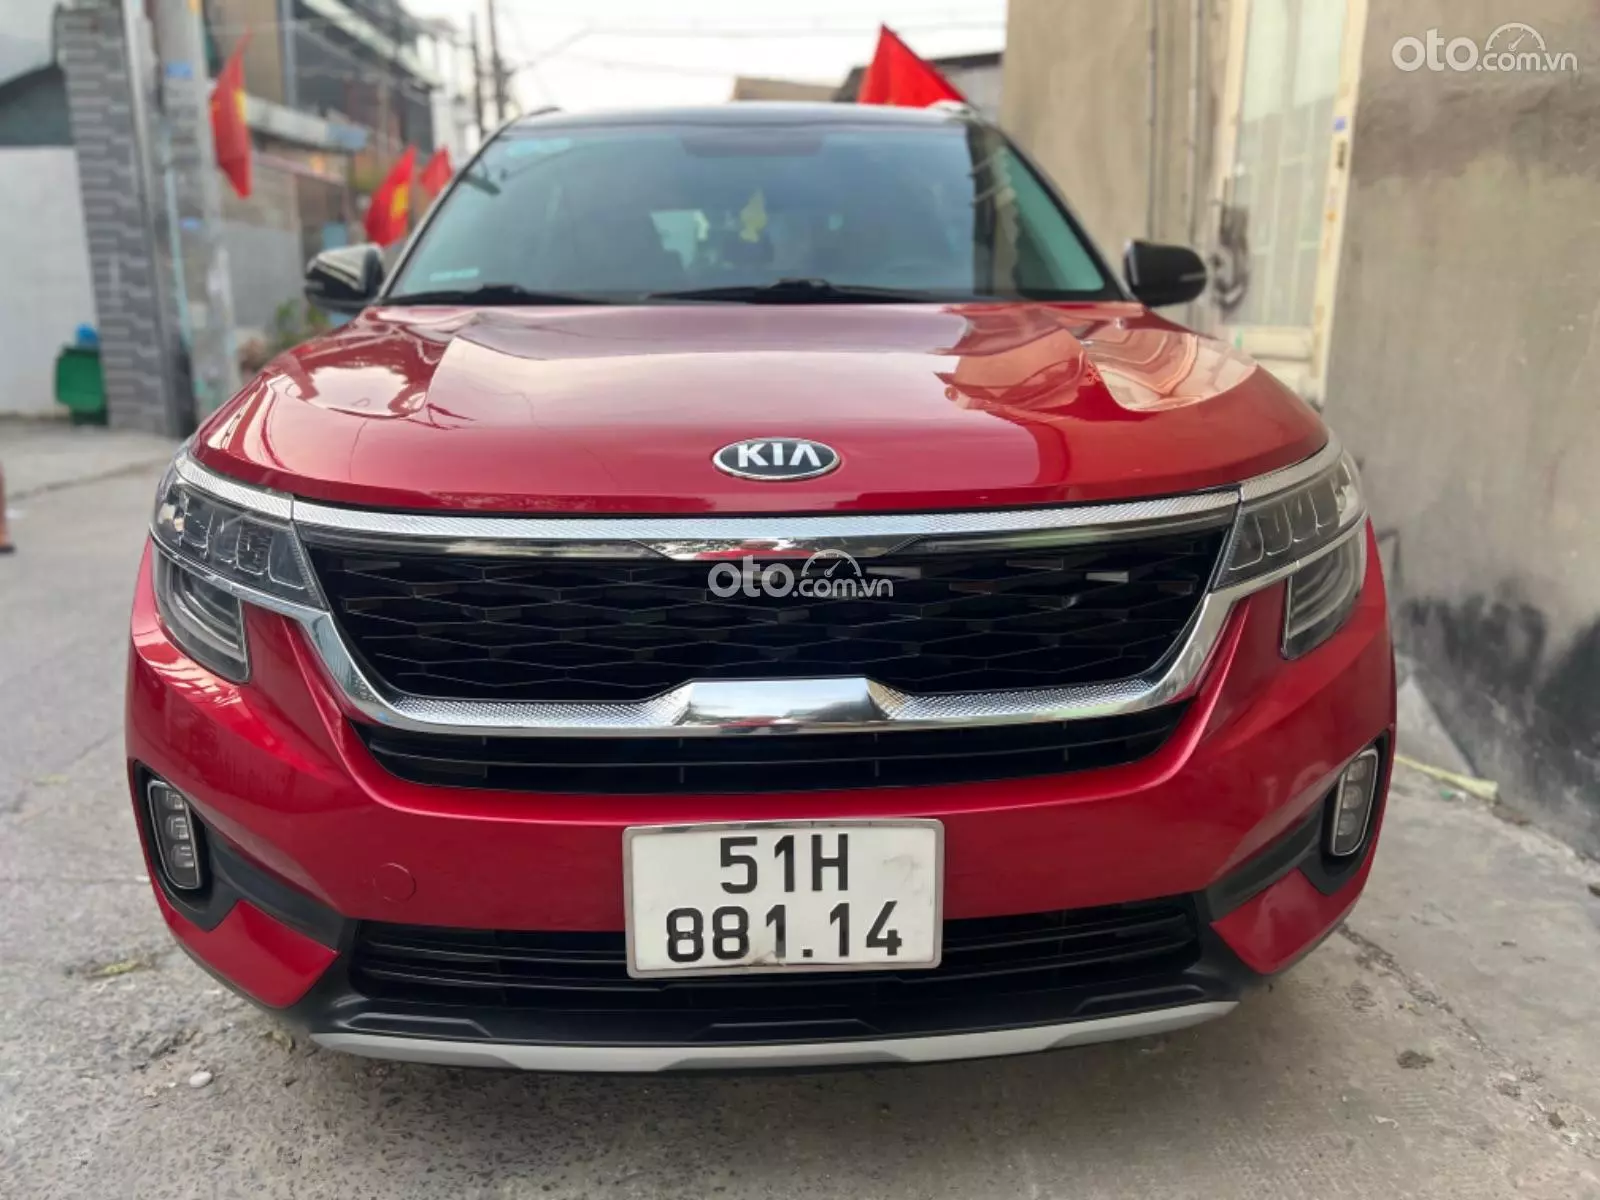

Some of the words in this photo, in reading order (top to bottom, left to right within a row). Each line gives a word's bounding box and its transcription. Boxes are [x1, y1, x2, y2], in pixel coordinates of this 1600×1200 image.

[737, 442, 822, 467] KIA
[720, 833, 848, 894] 51H
[666, 901, 902, 962] 881.14
